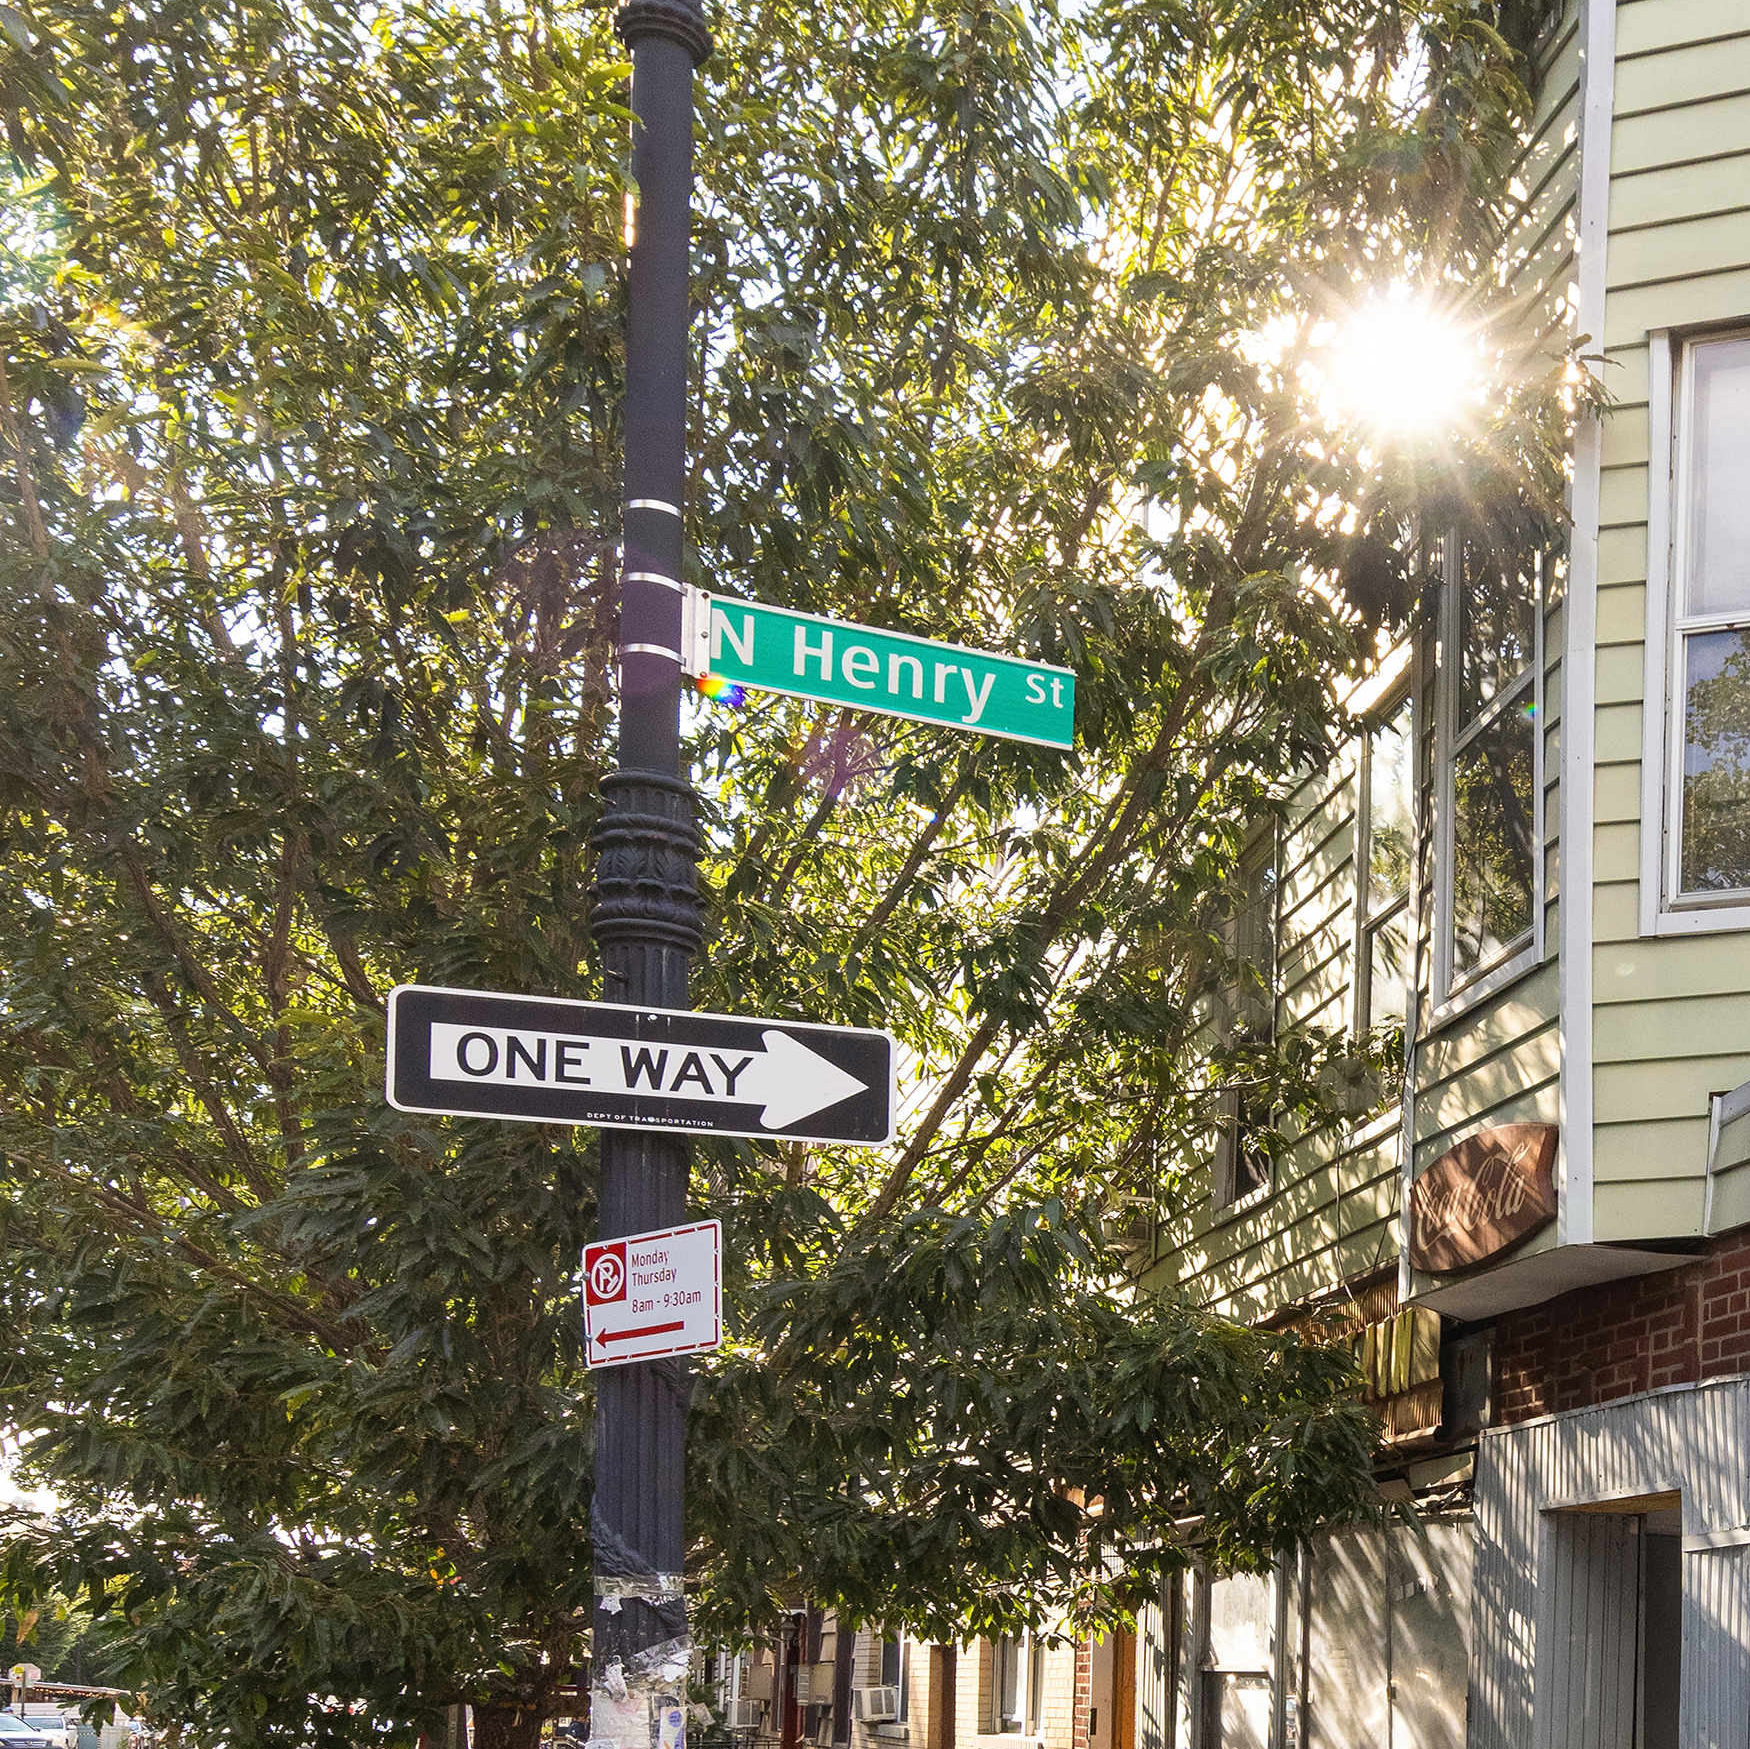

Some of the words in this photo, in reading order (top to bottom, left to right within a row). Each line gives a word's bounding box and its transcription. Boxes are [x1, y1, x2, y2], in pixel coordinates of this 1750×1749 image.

[711, 609, 754, 667] N
[793, 624, 996, 725] Henry
[1025, 673, 1064, 709] St
[456, 1032, 591, 1085] ONE
[620, 1045, 754, 1096] WAY
[587, 1112, 611, 1120] DEPT
[629, 1115, 714, 1127] TRASPORTATION
[631, 1250, 670, 1268] Monday
[632, 1267, 677, 1287] Thursday
[632, 1298, 654, 1313] 8am
[663, 1290, 702, 1308] 9:30am
